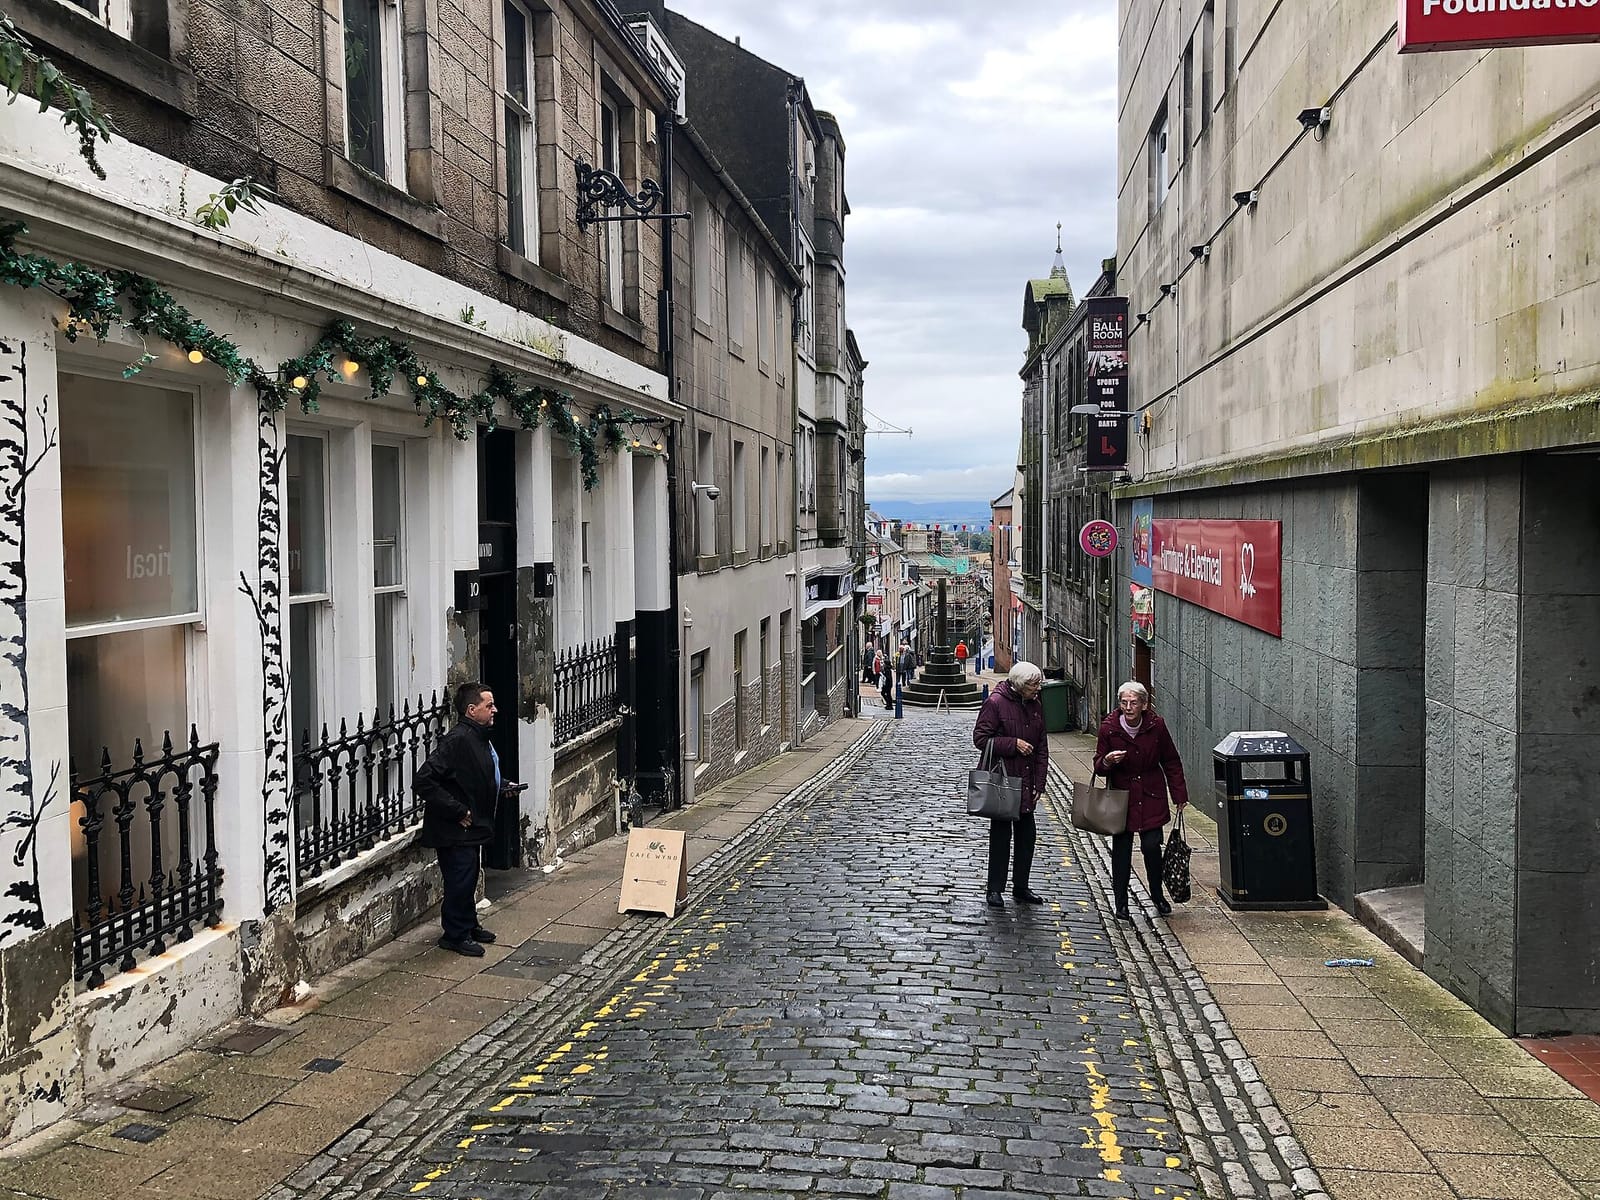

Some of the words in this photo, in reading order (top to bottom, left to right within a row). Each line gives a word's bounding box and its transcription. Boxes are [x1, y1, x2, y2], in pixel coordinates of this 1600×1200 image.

[1093, 321, 1122, 331] BALL
[1093, 331, 1122, 340] ROOM
[1096, 378, 1119, 386] SPORTS
[1101, 387, 1114, 395] BAR
[1100, 400, 1115, 408] POOL
[1098, 420, 1117, 428] DARTS
[1160, 540, 1184, 576] Furniture
[1184, 543, 1190, 578] &
[1190, 544, 1222, 586] Electrical
[546, 573, 553, 586] 10
[470, 582, 479, 597] 10
